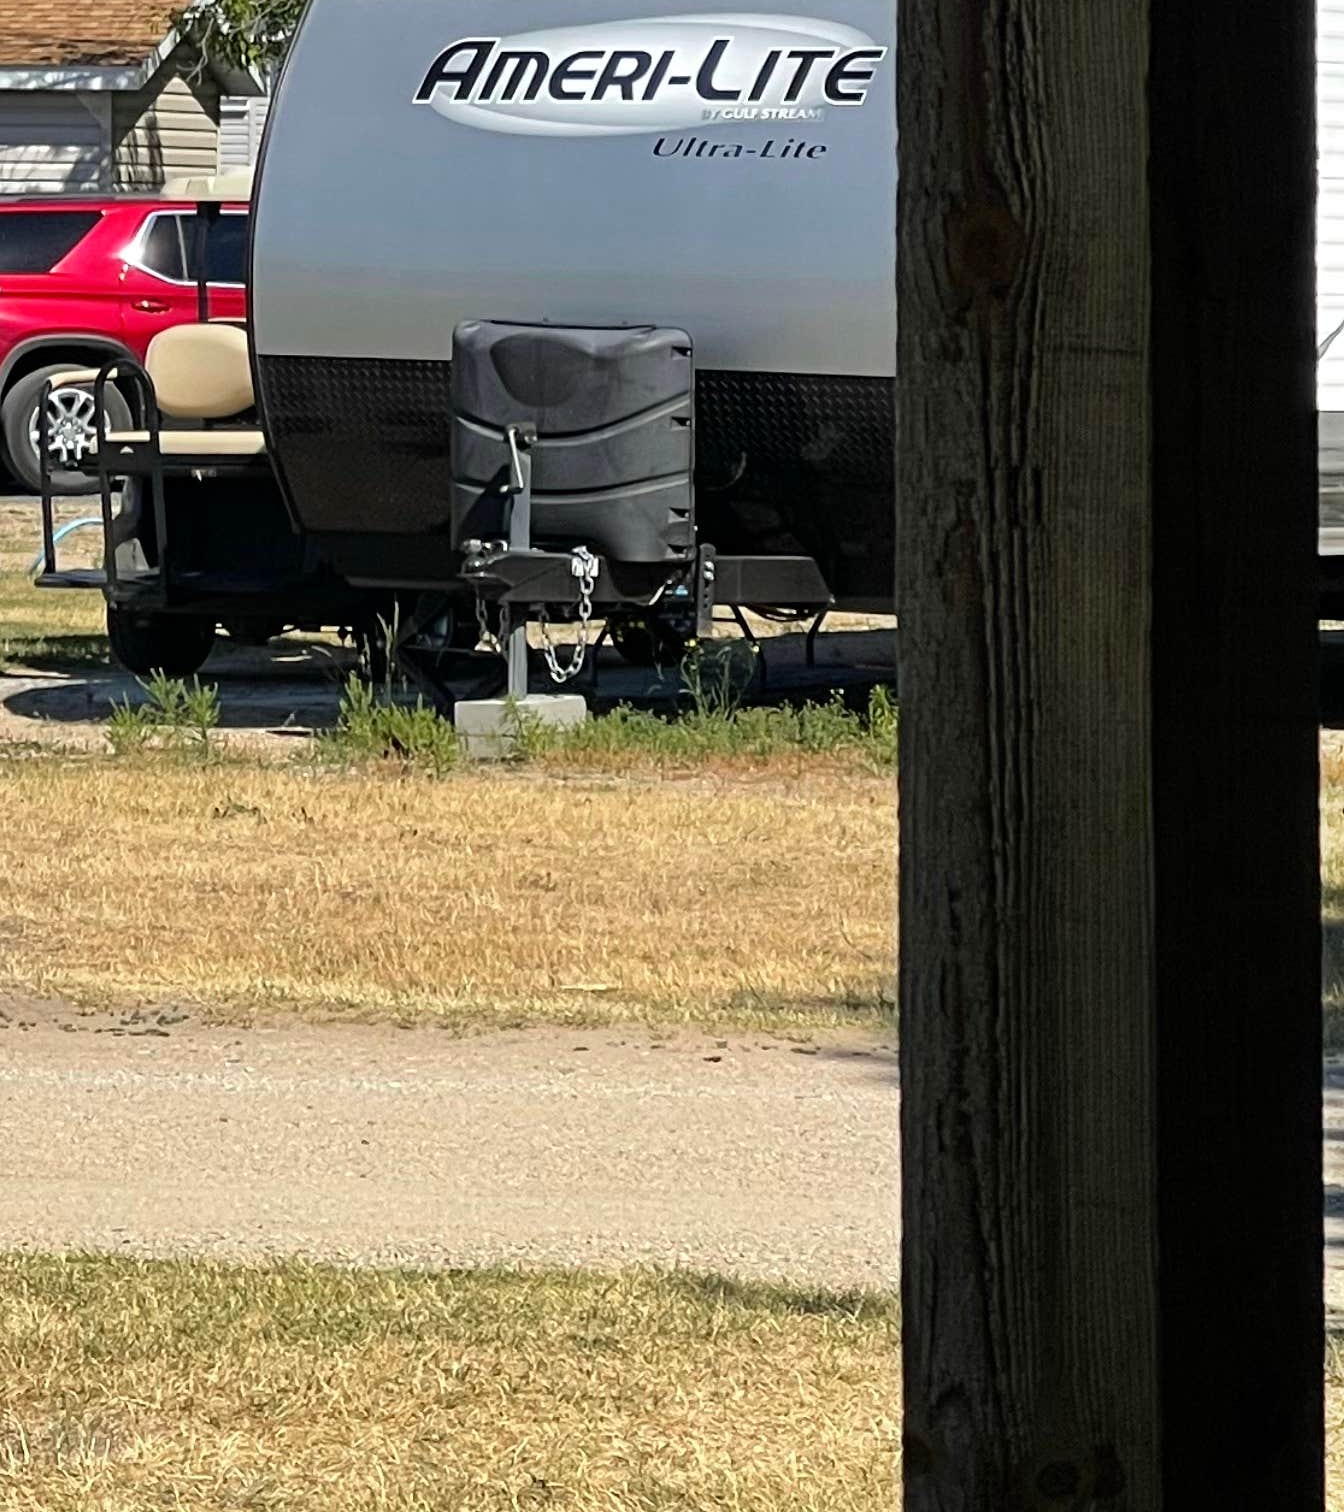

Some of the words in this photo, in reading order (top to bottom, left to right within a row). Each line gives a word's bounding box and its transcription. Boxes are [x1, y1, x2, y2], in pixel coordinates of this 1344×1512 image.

[413, 37, 888, 105] AMERI-LITE
[721, 108, 758, 120] GULF
[759, 108, 823, 121] STREAM
[653, 137, 828, 160] Ultra-Lite
